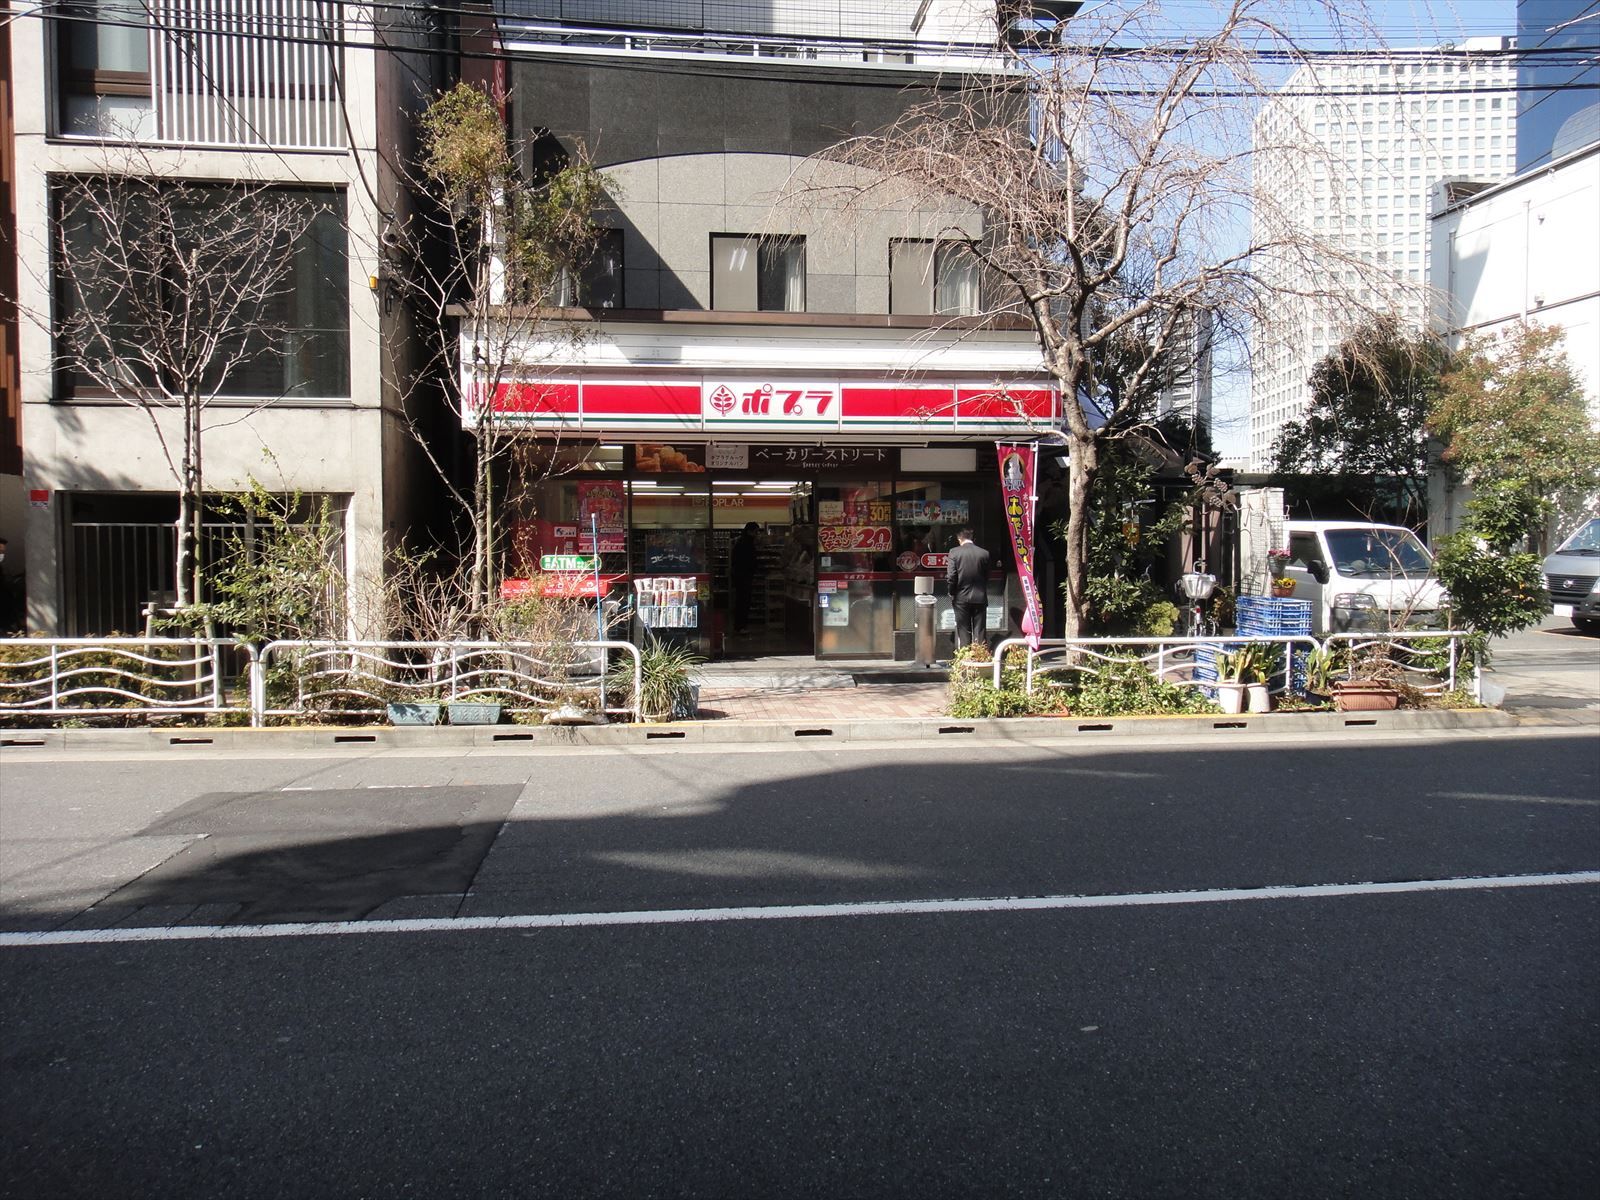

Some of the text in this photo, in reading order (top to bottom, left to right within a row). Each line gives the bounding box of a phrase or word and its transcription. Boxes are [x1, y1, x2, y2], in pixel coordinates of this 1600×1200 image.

[742, 383, 834, 416] ポプラ
[755, 447, 887, 462] ベーカリーストリート
[705, 498, 744, 507] OPLAR
[551, 557, 577, 569] ATM
